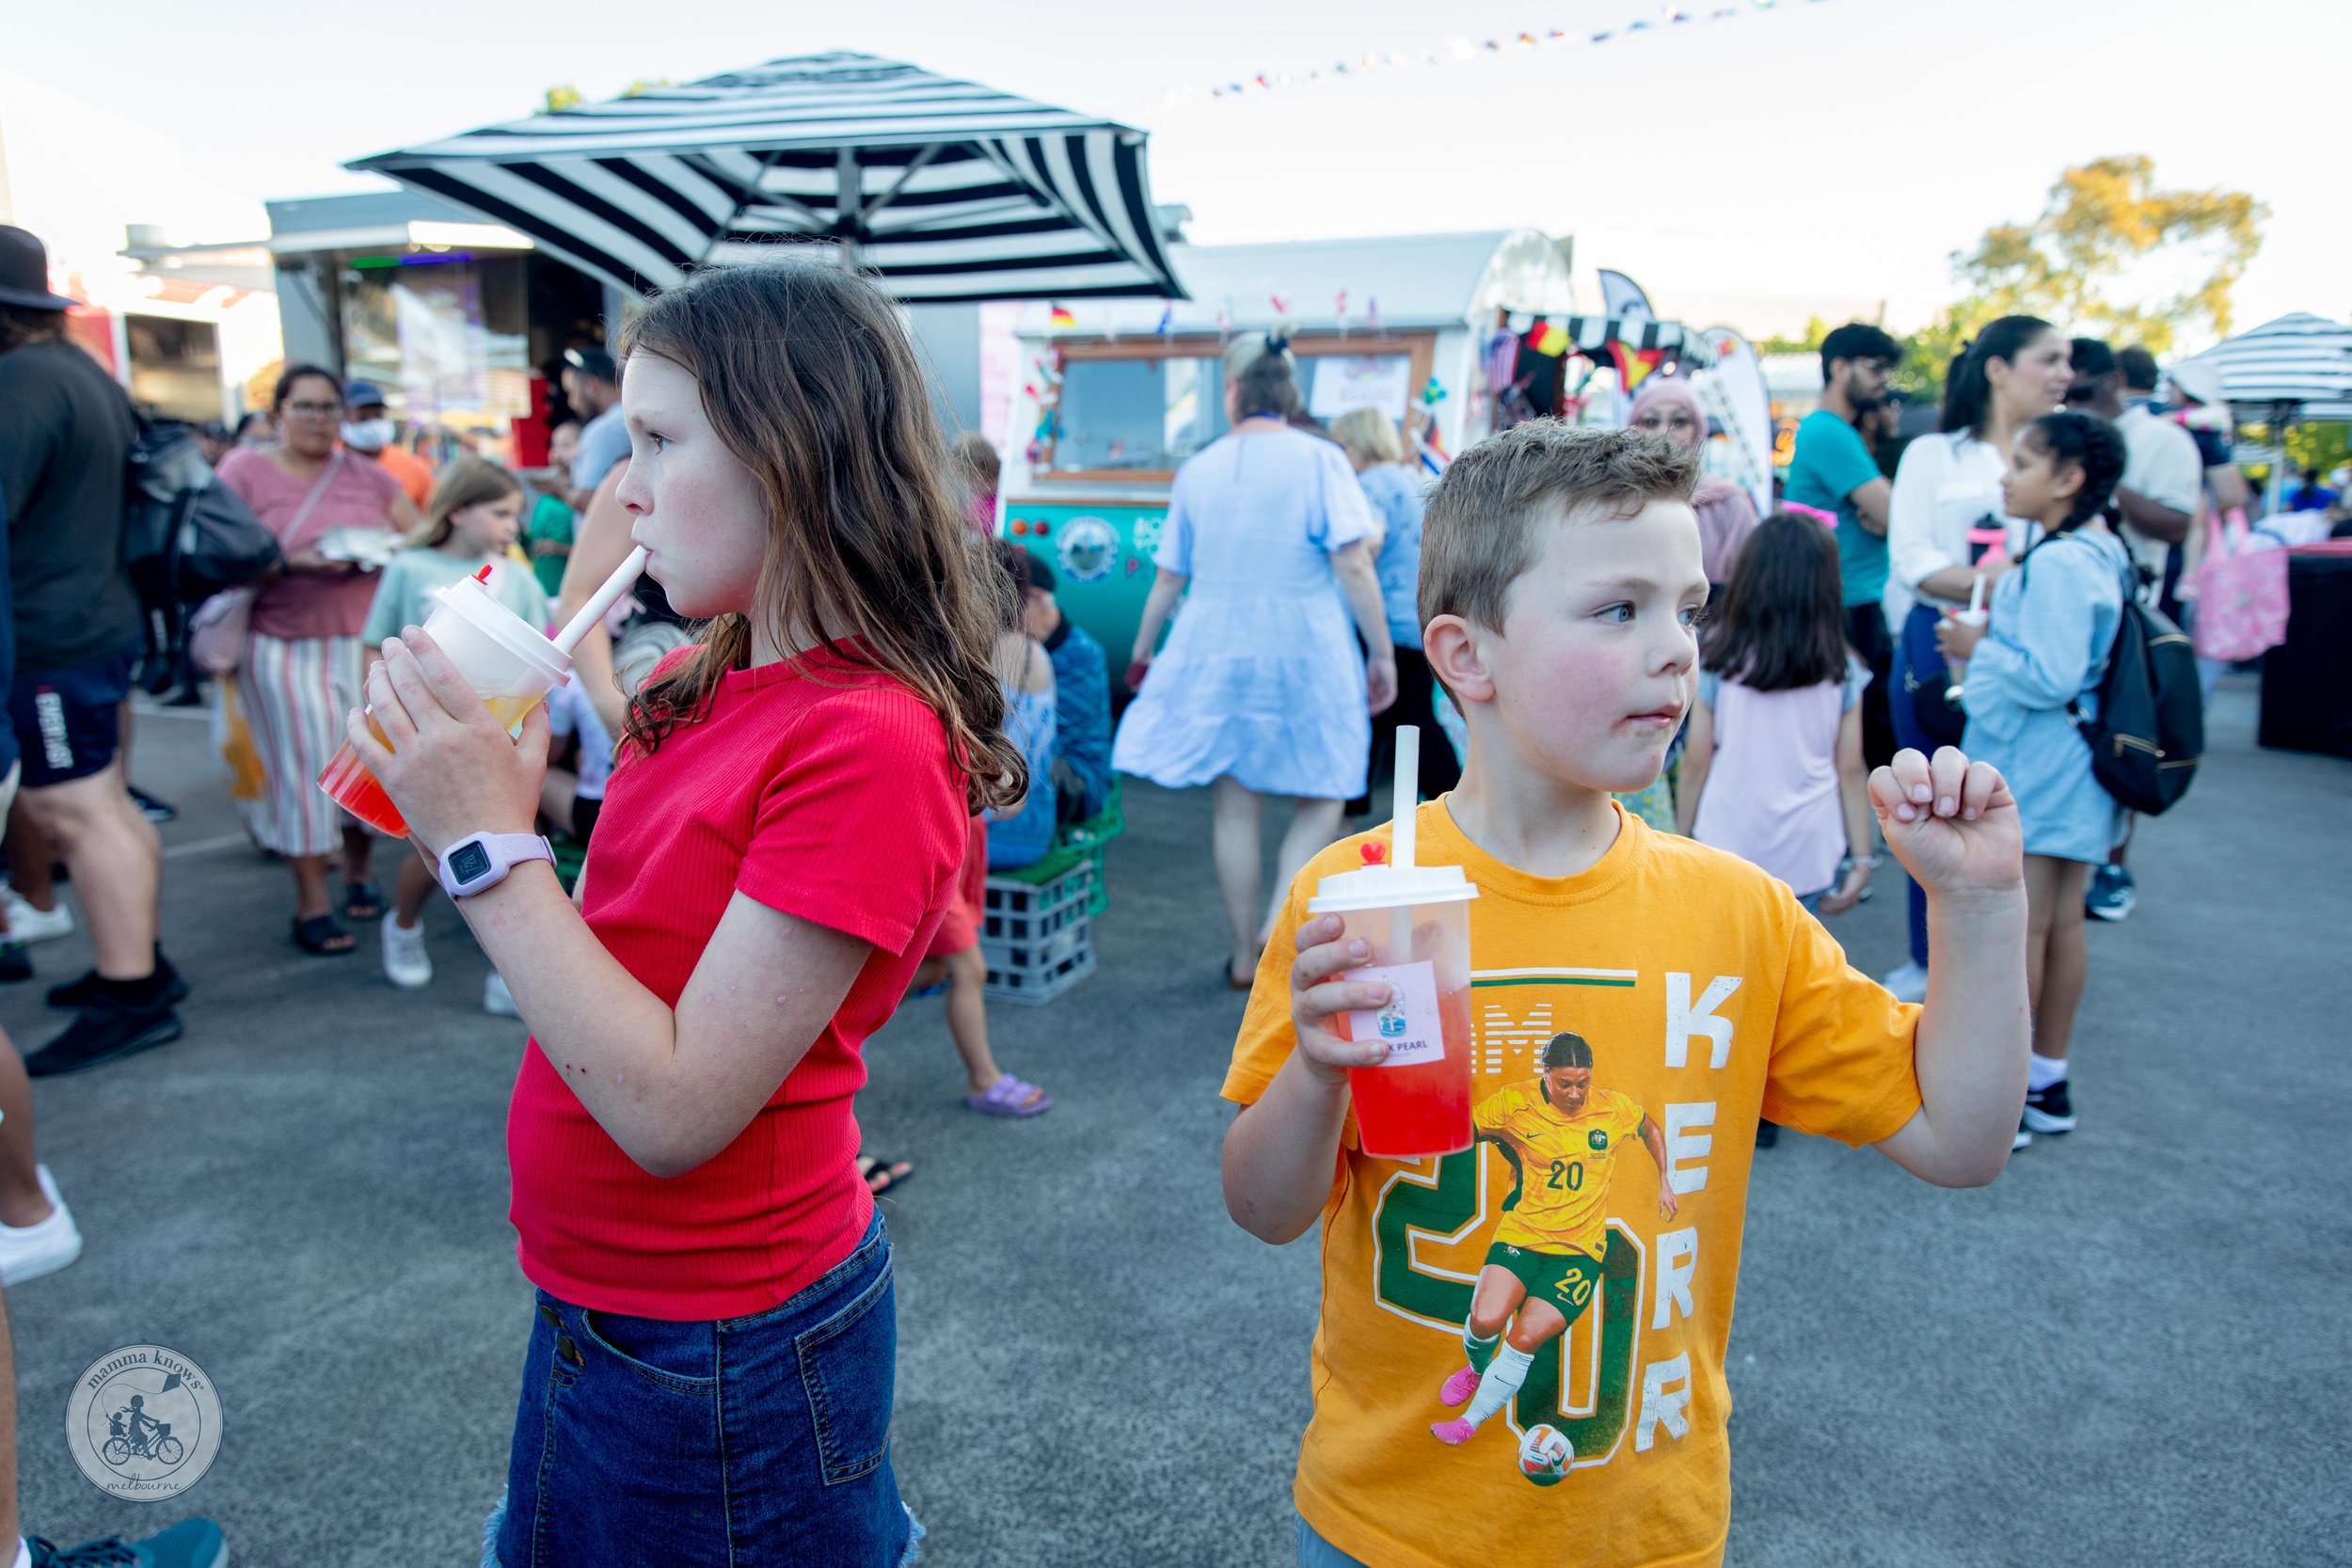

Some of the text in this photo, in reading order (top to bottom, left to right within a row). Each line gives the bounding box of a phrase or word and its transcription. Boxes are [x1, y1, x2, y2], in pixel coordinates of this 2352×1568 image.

[1397, 1040, 1428, 1052] PEARL
[1547, 1159, 1583, 1192] 20
[1635, 972, 1743, 1452] KERR
[1373, 1140, 1645, 1469] 20
[1554, 1267, 1591, 1307] 20
